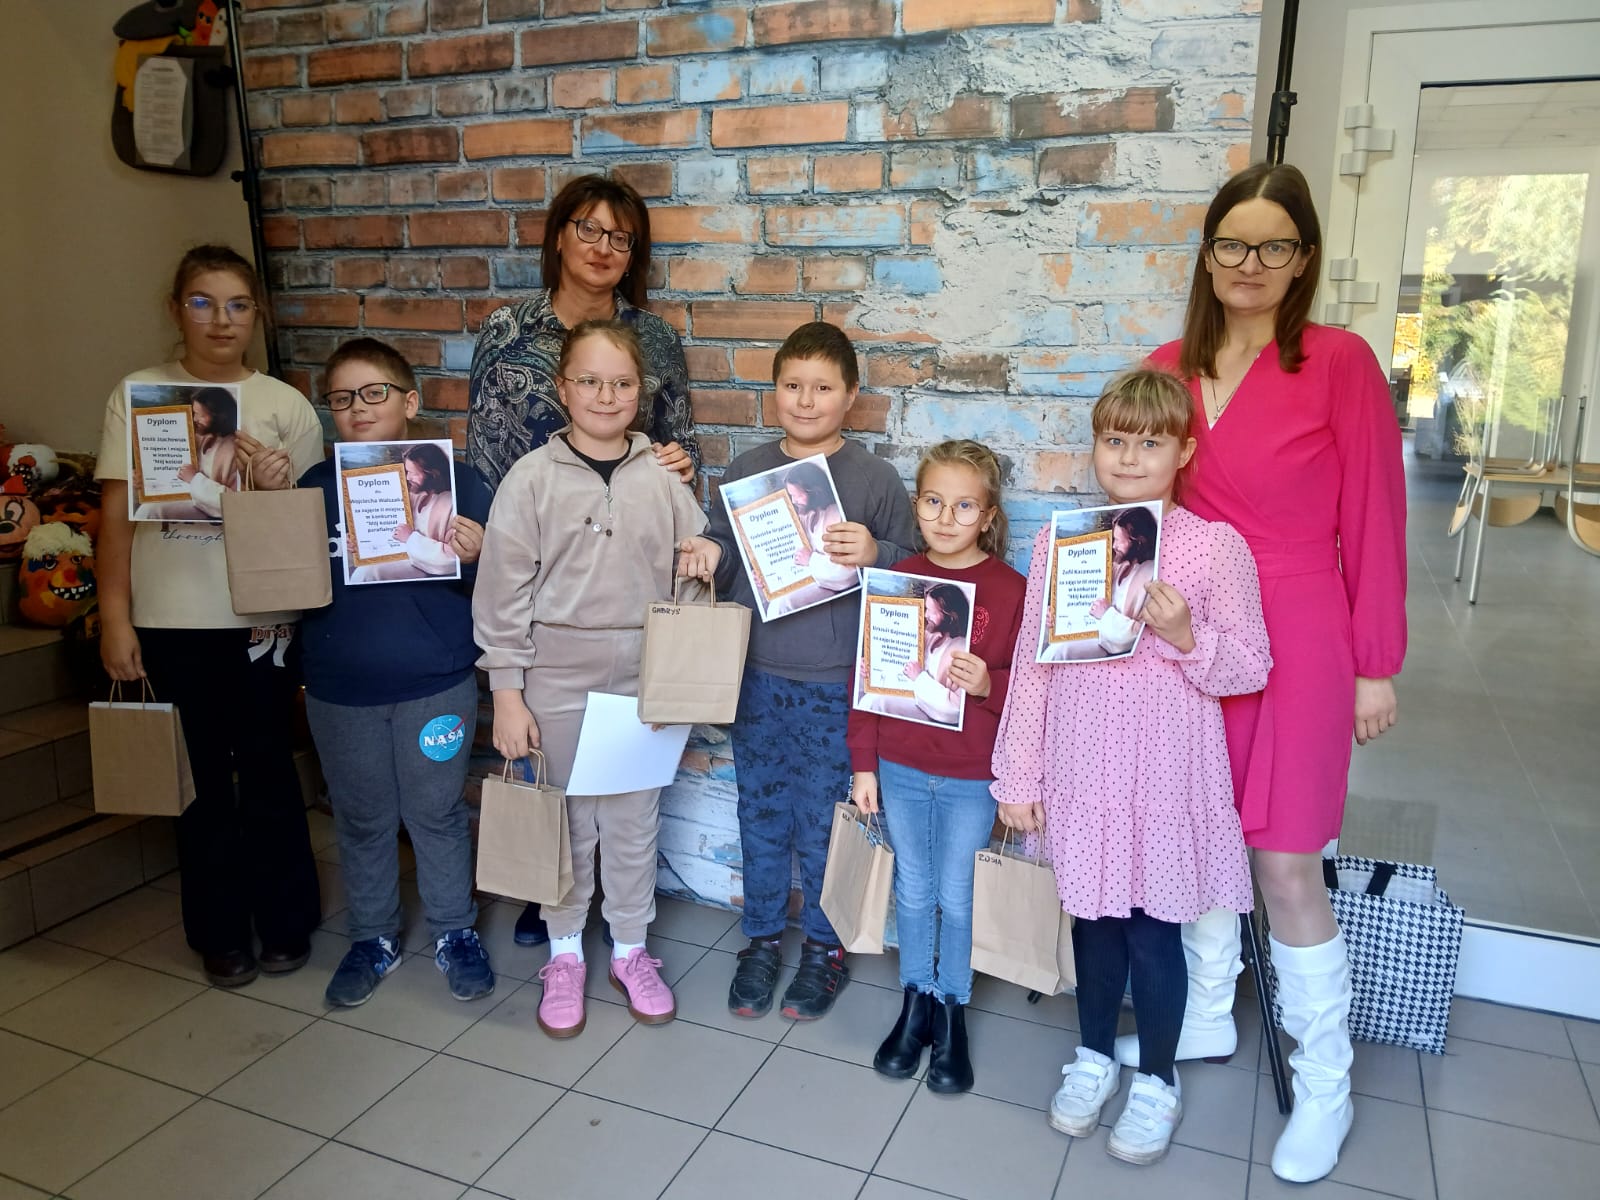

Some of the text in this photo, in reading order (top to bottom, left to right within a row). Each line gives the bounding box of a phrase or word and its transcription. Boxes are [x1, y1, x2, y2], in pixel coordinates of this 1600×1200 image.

[147, 418, 177, 426] Dyplom
[749, 508, 779, 522] Dyplom
[1068, 548, 1096, 558] Dyplom
[880, 607, 909, 619] Dyplom
[424, 729, 464, 746] NASA
